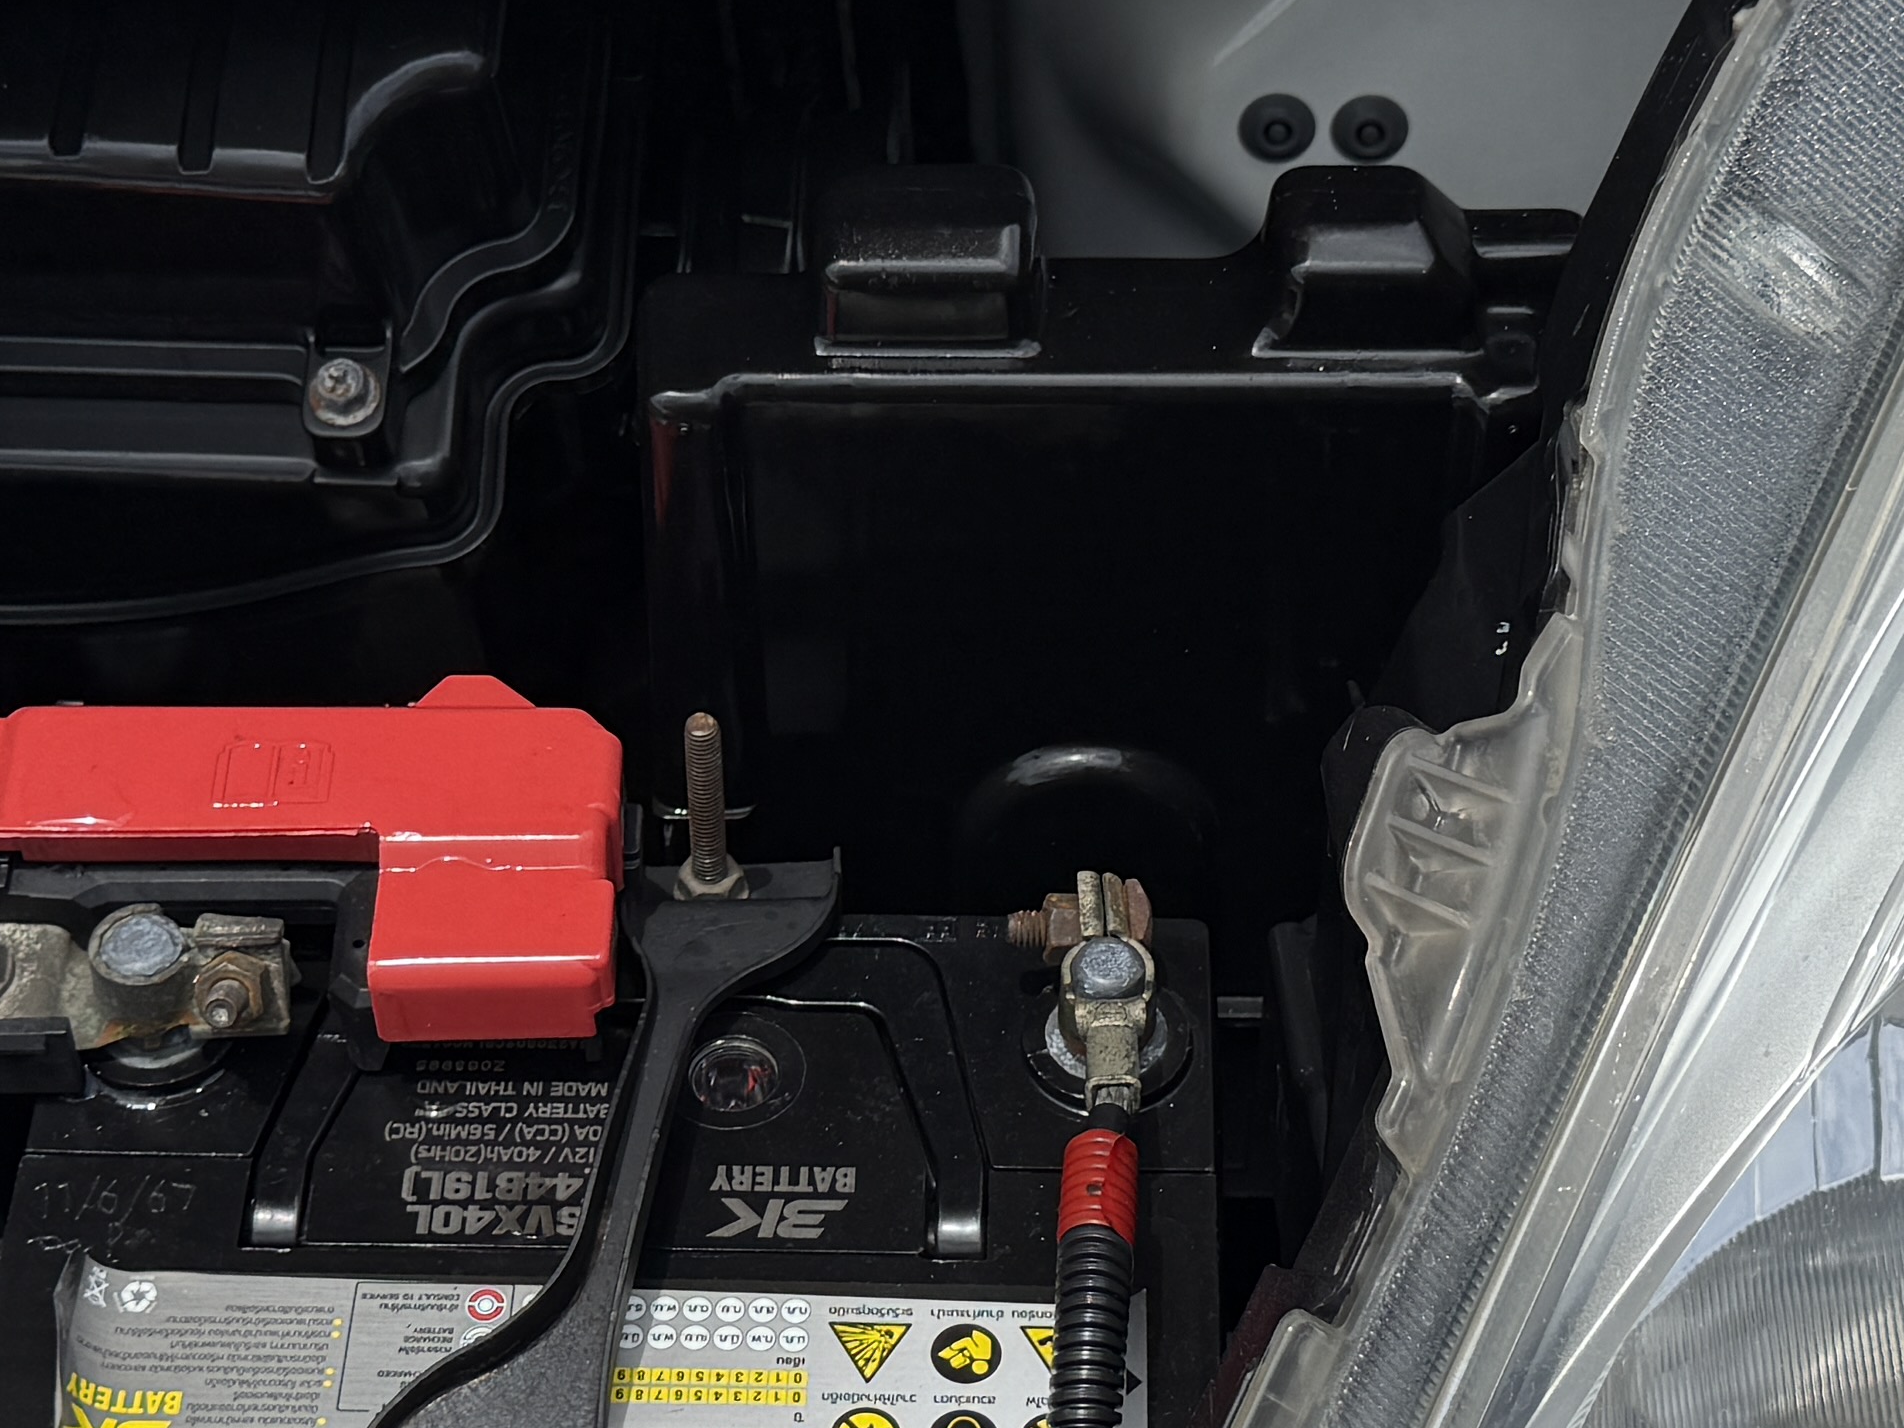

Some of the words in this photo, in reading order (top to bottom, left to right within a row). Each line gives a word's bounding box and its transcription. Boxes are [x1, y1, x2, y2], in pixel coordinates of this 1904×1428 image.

[416, 1080, 516, 1096] THAILAND
[523, 1081, 543, 1096] IN
[550, 1082, 608, 1096] MADE
[455, 1102, 518, 1118] CLASS
[498, 1123, 511, 1142] /
[515, 1122, 570, 1143] (CCA)
[543, 1146, 556, 1164] /
[558, 1146, 595, 1164] 12V
[401, 1165, 587, 1202] 44B19L)
[710, 1165, 856, 1193] BATTERY
[406, 1204, 581, 1237] SVX40L
[705, 1198, 848, 1239] 3K
[617, 1370, 625, 1380] 9
[638, 1371, 645, 1381] 8
[656, 1371, 665, 1381] 7
[677, 1371, 684, 1381] 6
[696, 1372, 704, 1382] 5
[715, 1372, 724, 1382] 4
[735, 1372, 743, 1382] 3
[754, 1372, 762, 1382] 2
[775, 1373, 781, 1383] 1
[794, 1373, 801, 1383] 0
[66, 1372, 183, 1415] BATTERY
[616, 1389, 624, 1399] 9
[636, 1390, 643, 1400] 8
[655, 1390, 663, 1400] 7
[675, 1390, 682, 1400] 6
[694, 1390, 702, 1401] 5
[714, 1391, 722, 1401] 4
[734, 1391, 742, 1401] 3
[753, 1391, 761, 1401] 2
[774, 1392, 780, 1402] 1
[793, 1392, 800, 1402] 0
